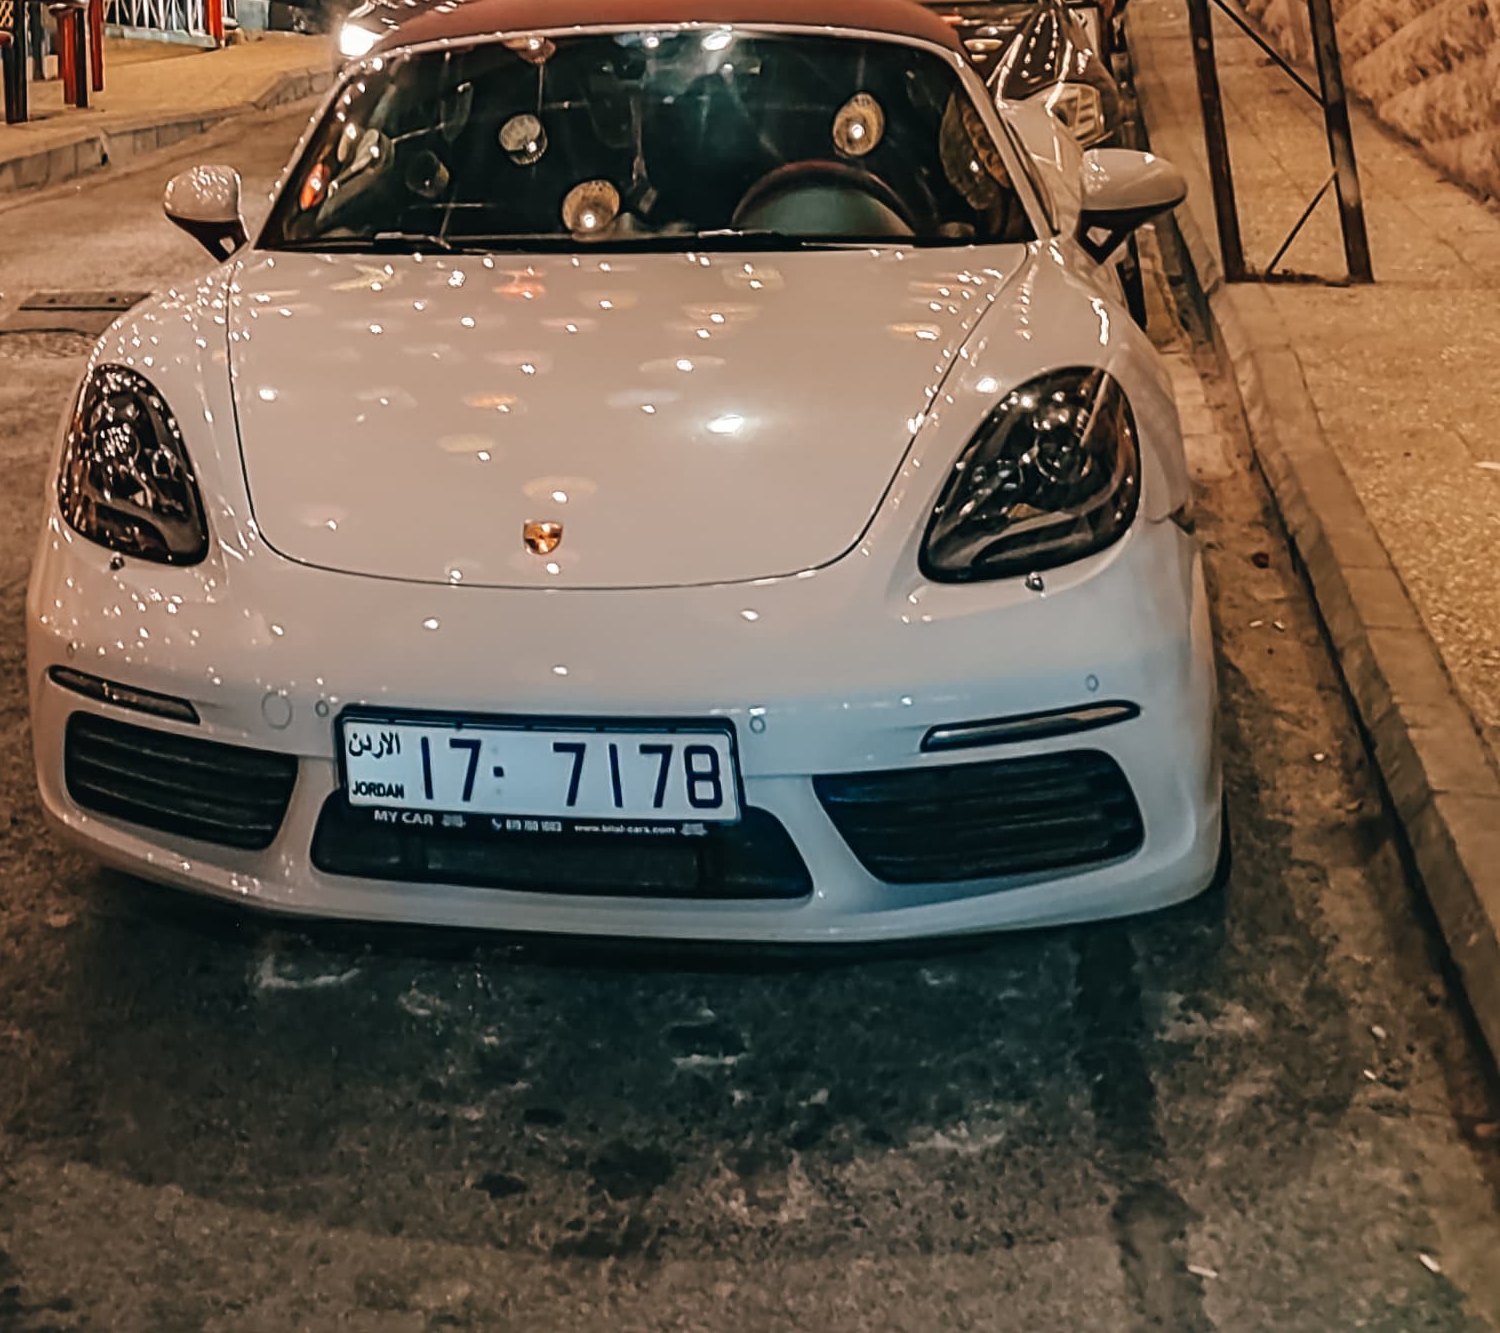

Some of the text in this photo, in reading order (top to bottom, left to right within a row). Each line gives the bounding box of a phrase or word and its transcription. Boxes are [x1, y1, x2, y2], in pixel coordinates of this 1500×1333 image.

[553, 742, 724, 809] 7178
[351, 780, 405, 800] JORDAN
[374, 809, 434, 826] MY CAR
